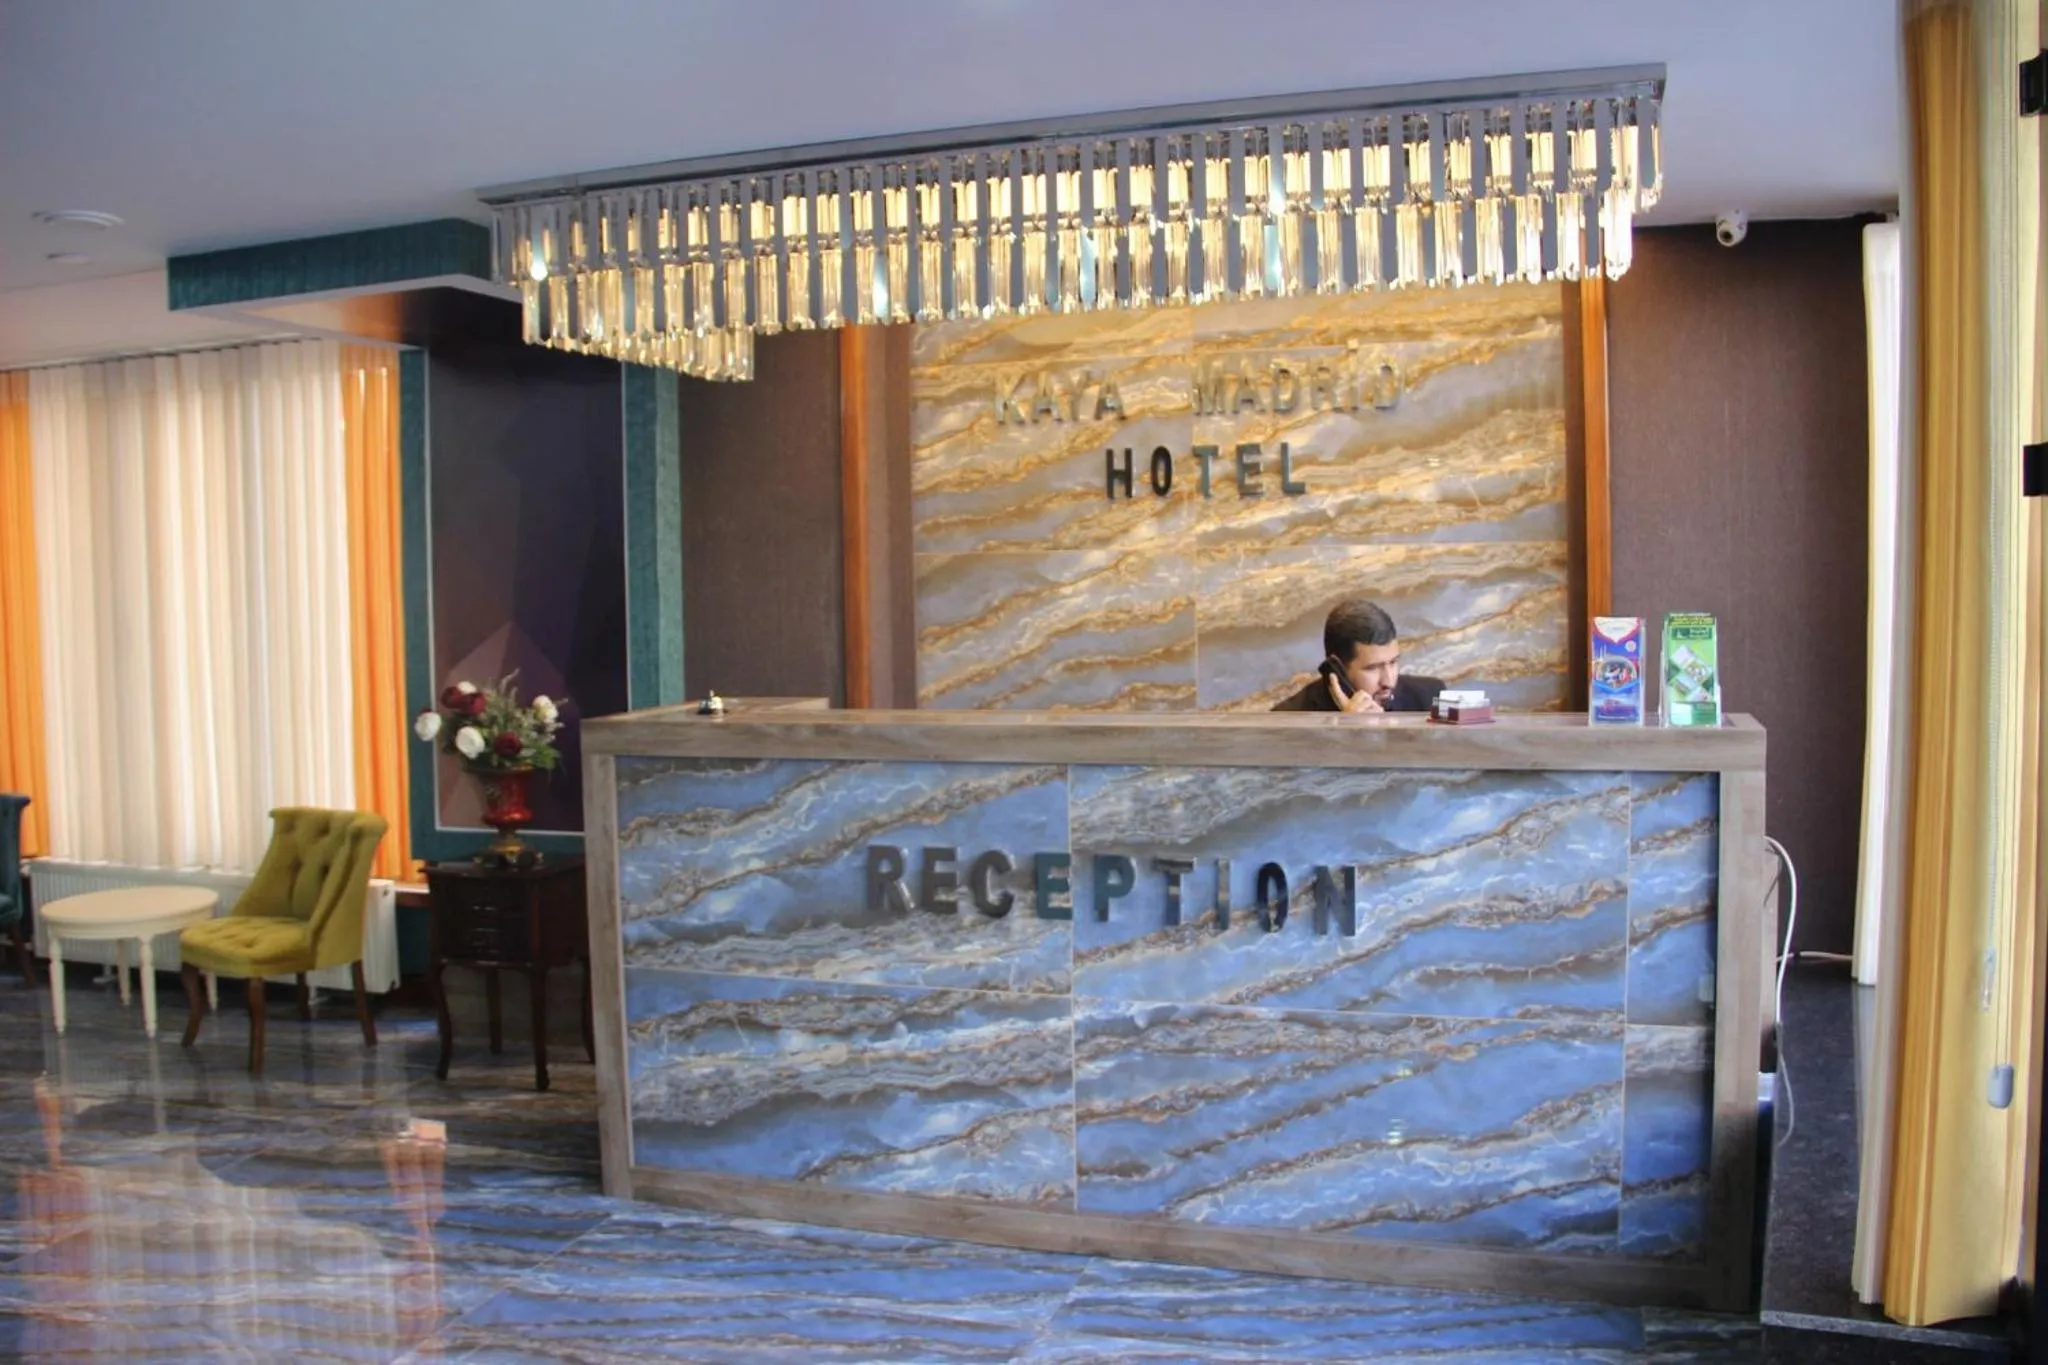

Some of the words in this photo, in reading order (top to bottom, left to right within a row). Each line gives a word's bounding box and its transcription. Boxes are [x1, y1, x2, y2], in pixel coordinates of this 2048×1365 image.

[995, 367, 1127, 424] KAYA
[1105, 441, 1306, 500] HOTEL
[866, 844, 1357, 937] RECEPTION
